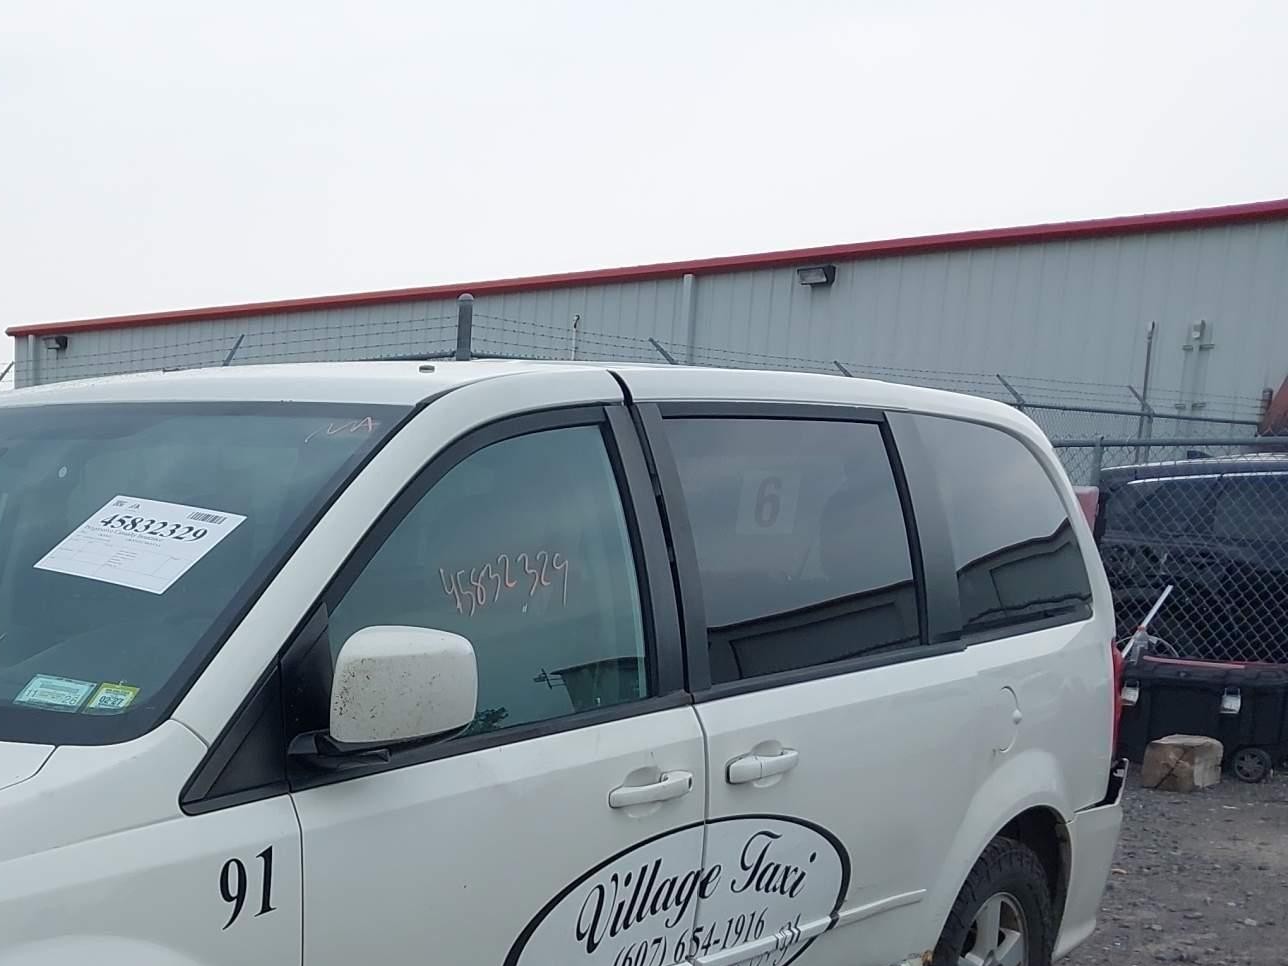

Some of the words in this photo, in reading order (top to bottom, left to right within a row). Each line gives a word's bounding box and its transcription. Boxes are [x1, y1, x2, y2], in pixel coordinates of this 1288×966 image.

[101, 513, 208, 542] 45832329
[755, 476, 782, 528] 6
[439, 551, 569, 617] 45832329
[219, 844, 277, 930] 91
[575, 857, 722, 954] Village
[730, 830, 816, 898] Taxi
[673, 906, 769, 964] 654-1916
